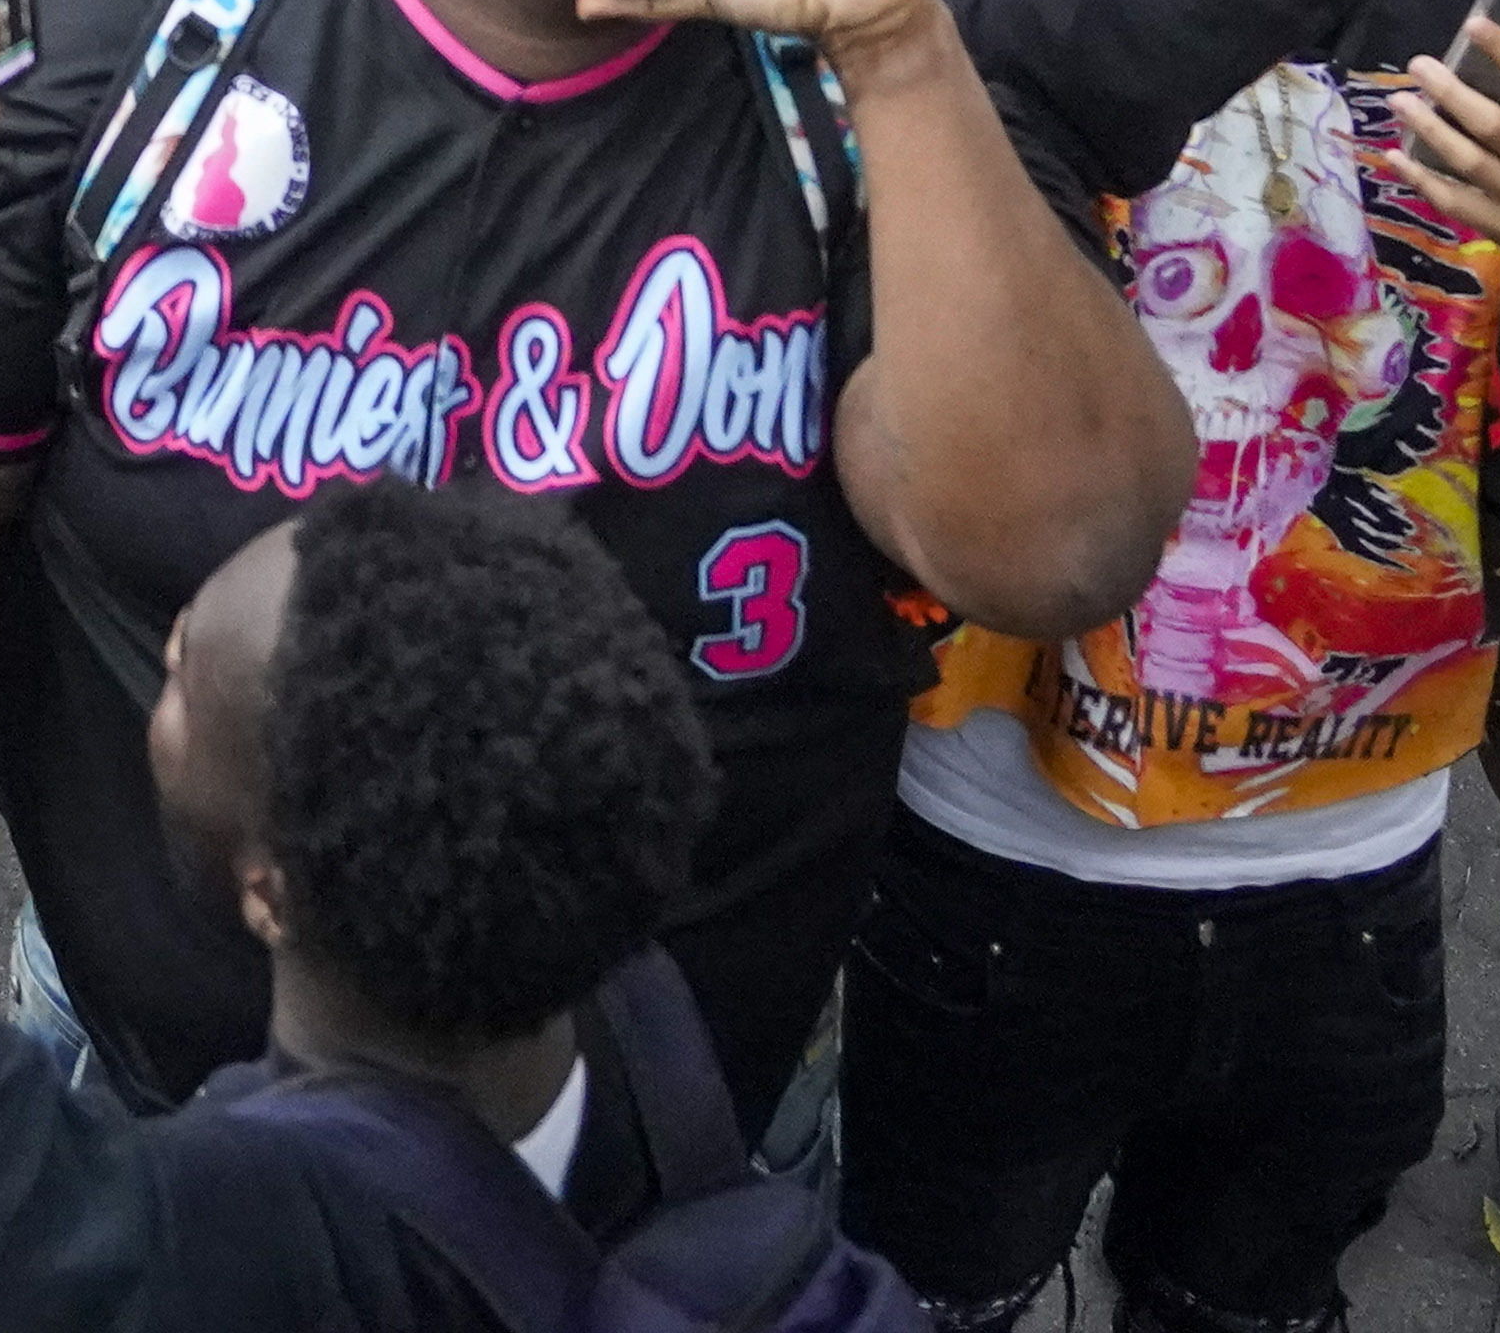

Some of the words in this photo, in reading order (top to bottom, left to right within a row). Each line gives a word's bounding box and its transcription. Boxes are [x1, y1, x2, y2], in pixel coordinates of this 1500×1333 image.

[98, 245, 474, 493] Bunnies
[489, 309, 594, 489] &
[604, 241, 827, 483] Don
[690, 520, 808, 681] 3
[1239, 709, 1413, 761] REALITY
